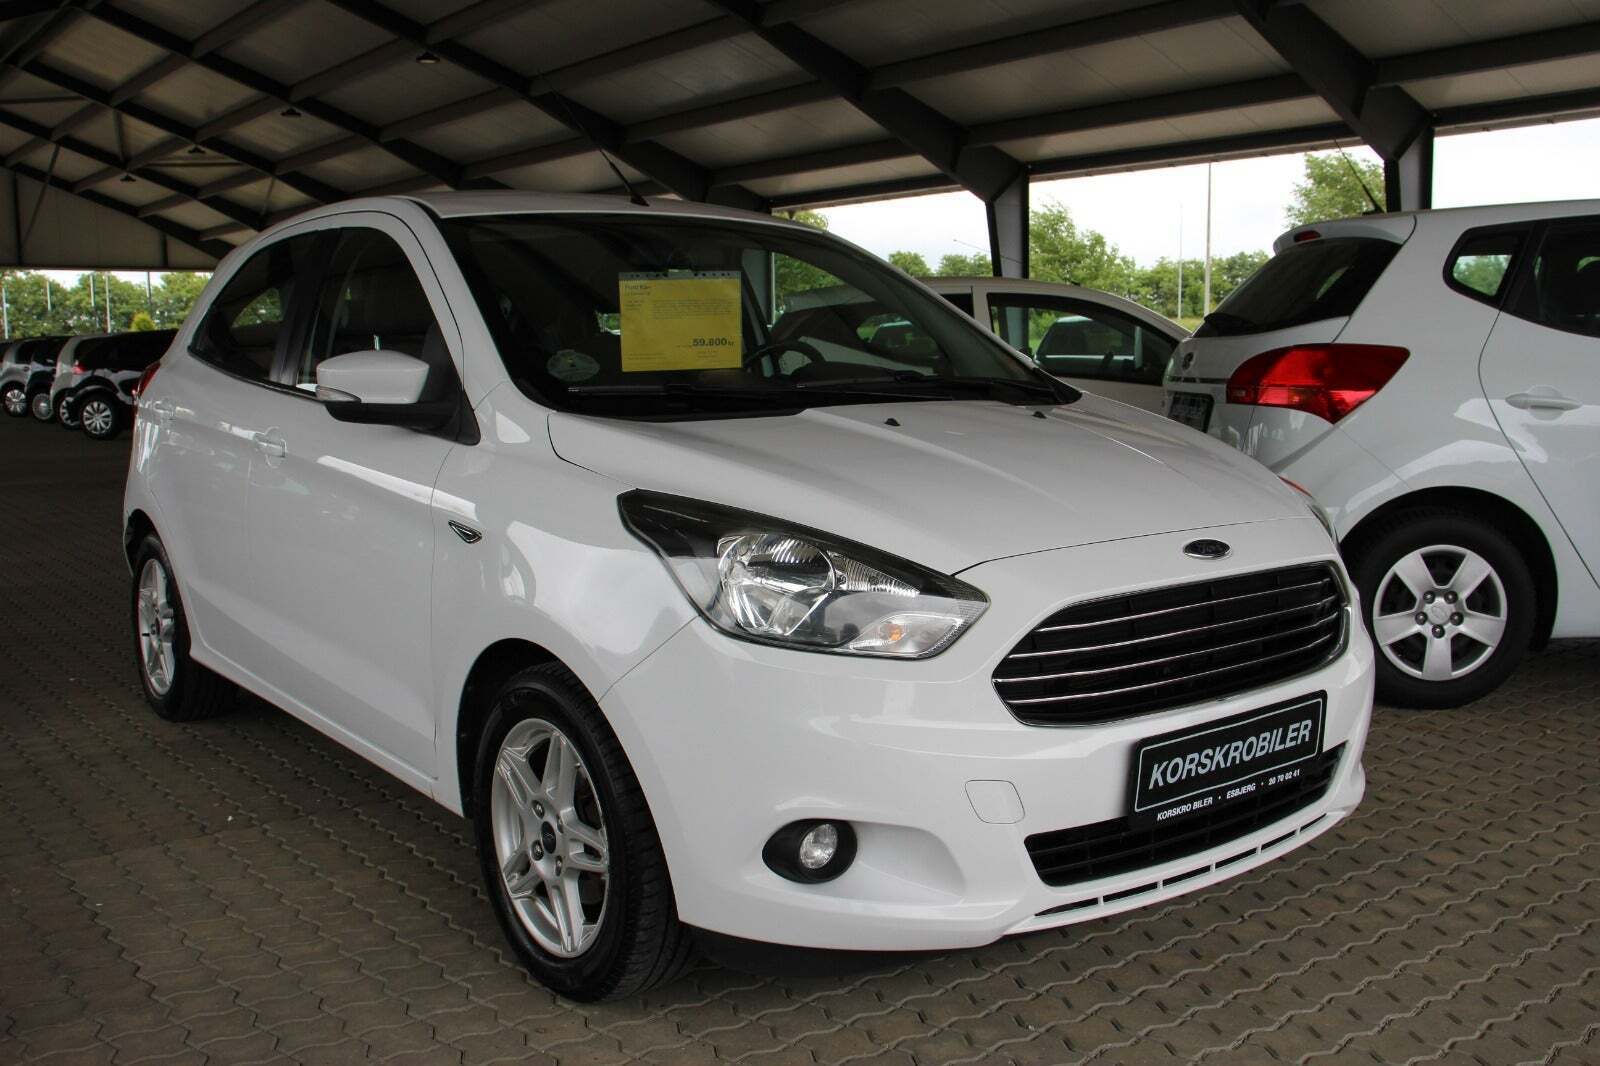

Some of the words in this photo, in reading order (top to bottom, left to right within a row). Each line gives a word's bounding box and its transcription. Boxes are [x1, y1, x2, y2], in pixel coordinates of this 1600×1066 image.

[1148, 719, 1313, 790] KORSKROBILER
[1156, 803, 1192, 821] KORSKRO
[1192, 796, 1213, 811] BILER
[1226, 782, 1256, 799] ESBJERG
